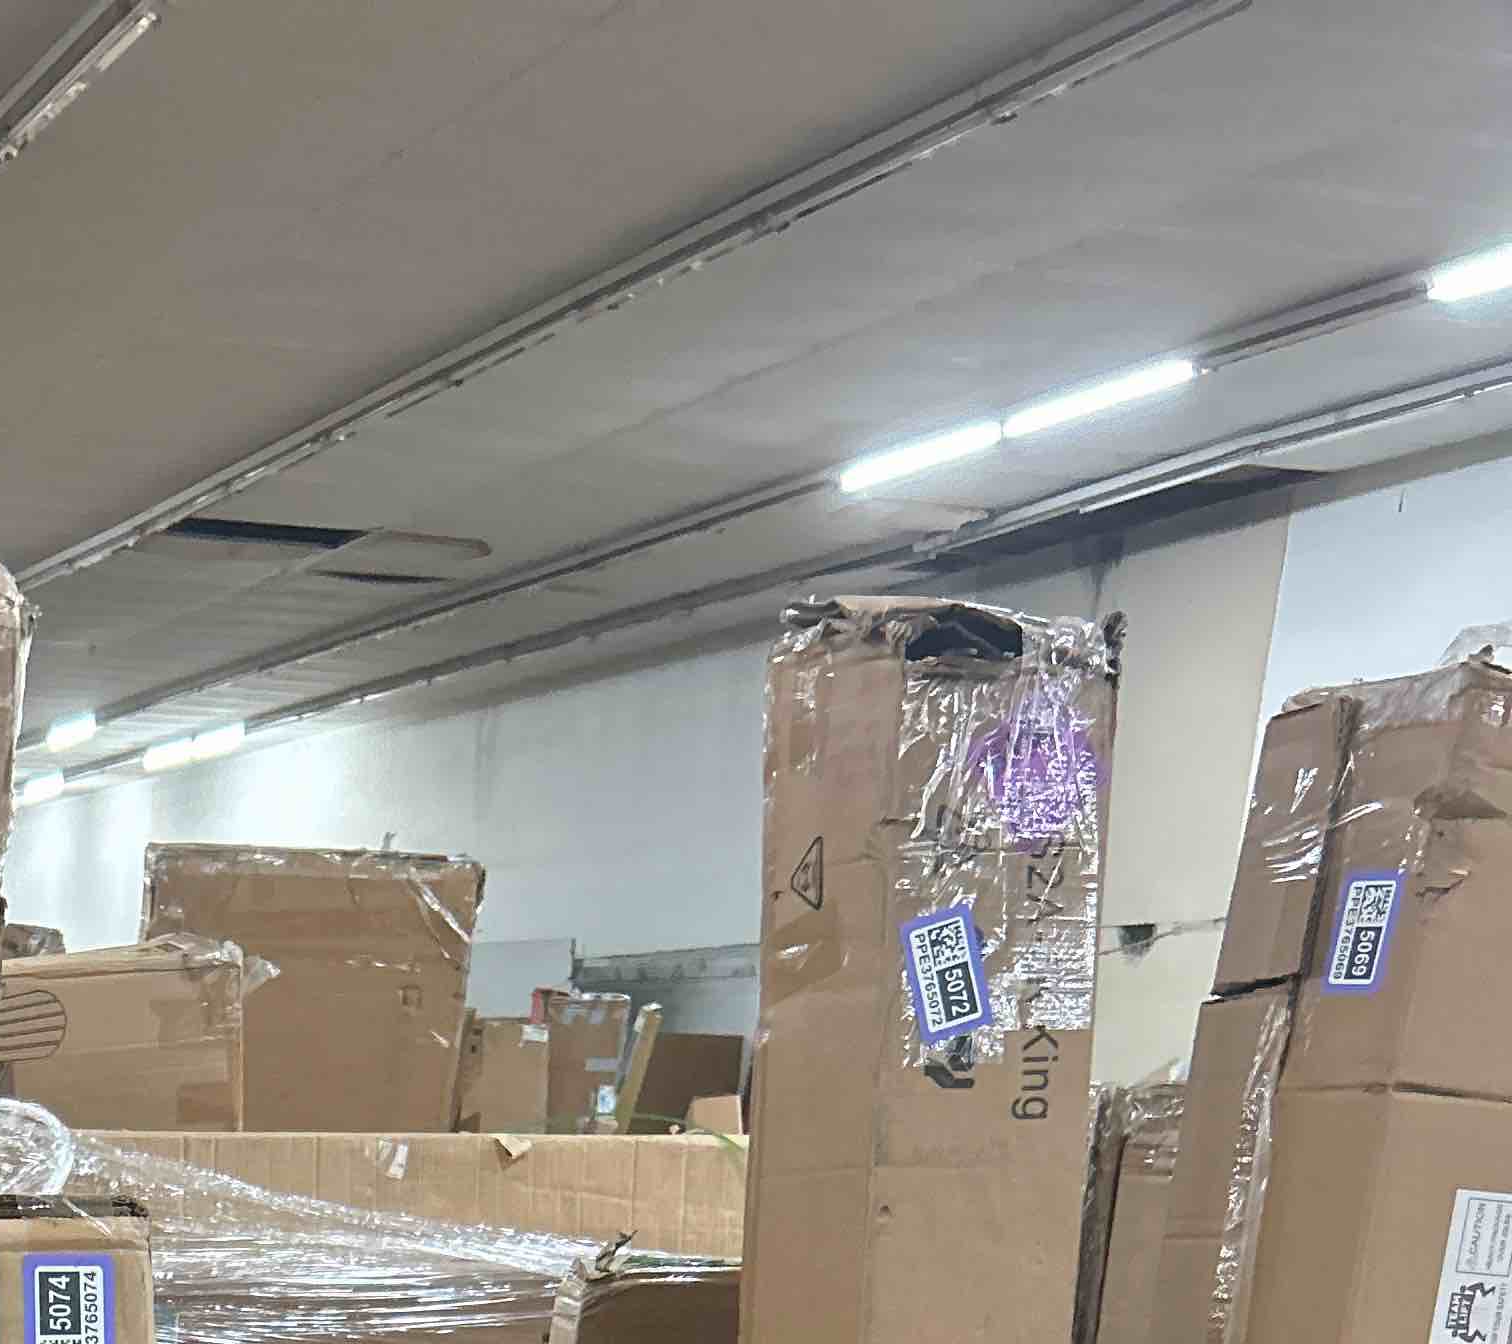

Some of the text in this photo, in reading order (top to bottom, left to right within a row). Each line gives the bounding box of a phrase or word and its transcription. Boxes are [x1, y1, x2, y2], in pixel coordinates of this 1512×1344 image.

[1352, 929, 1376, 977] 5069
[914, 932, 944, 1027] PPE3765072
[943, 967, 971, 1017] 5072
[1469, 1202, 1486, 1257] CAUTION
[48, 1275, 72, 1331] 5074
[1446, 1294, 1461, 1327] TEAM
